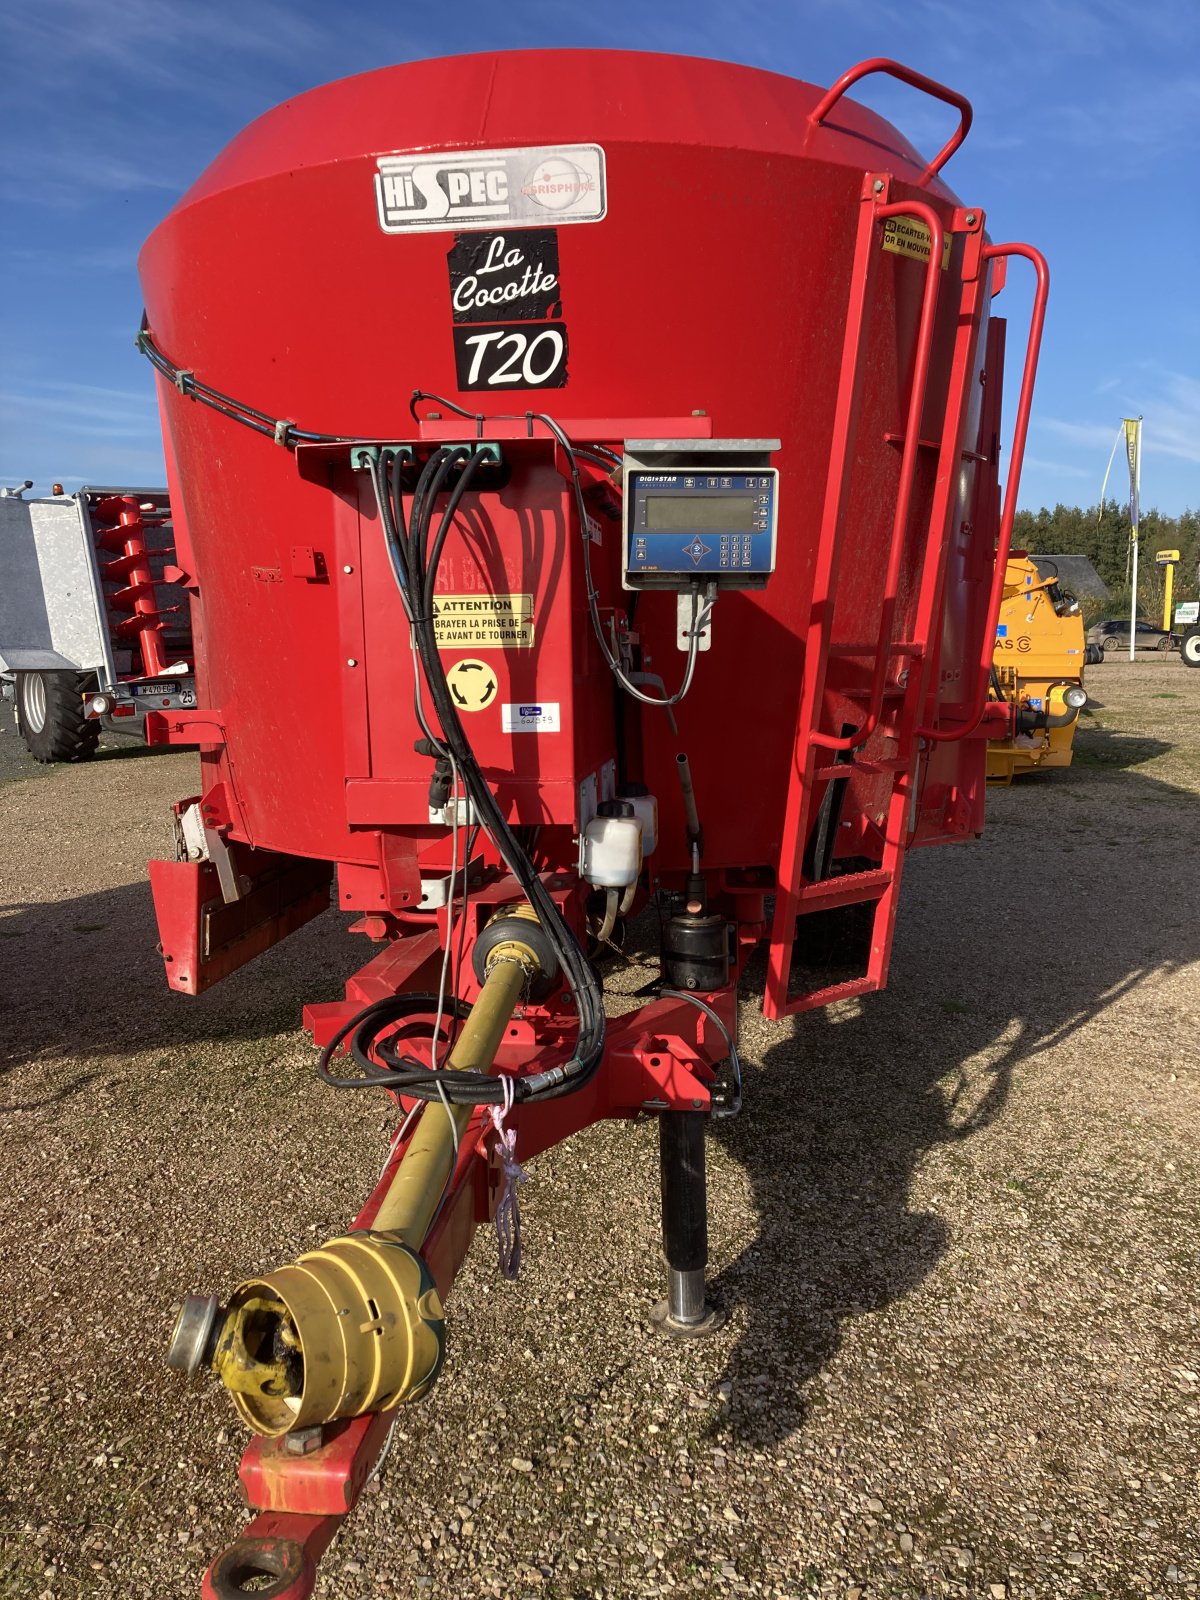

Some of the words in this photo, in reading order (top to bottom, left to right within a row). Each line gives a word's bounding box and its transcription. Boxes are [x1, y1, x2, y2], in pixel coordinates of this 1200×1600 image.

[884, 234, 895, 245] OR
[897, 238, 905, 248] EN
[897, 225, 931, 243] ECARTER-V
[476, 236, 524, 274] La
[453, 263, 558, 312] Cocotte
[465, 330, 564, 385] T20
[443, 601, 512, 611] ATTENTION
[435, 619, 467, 629] BRAYER
[469, 619, 480, 628] LA
[482, 619, 506, 628] PRISE
[509, 618, 520, 627] DE
[447, 631, 473, 640] AVANT
[476, 631, 486, 640] DE
[489, 630, 528, 639] TOURNER
[182, 690, 193, 703] 25
